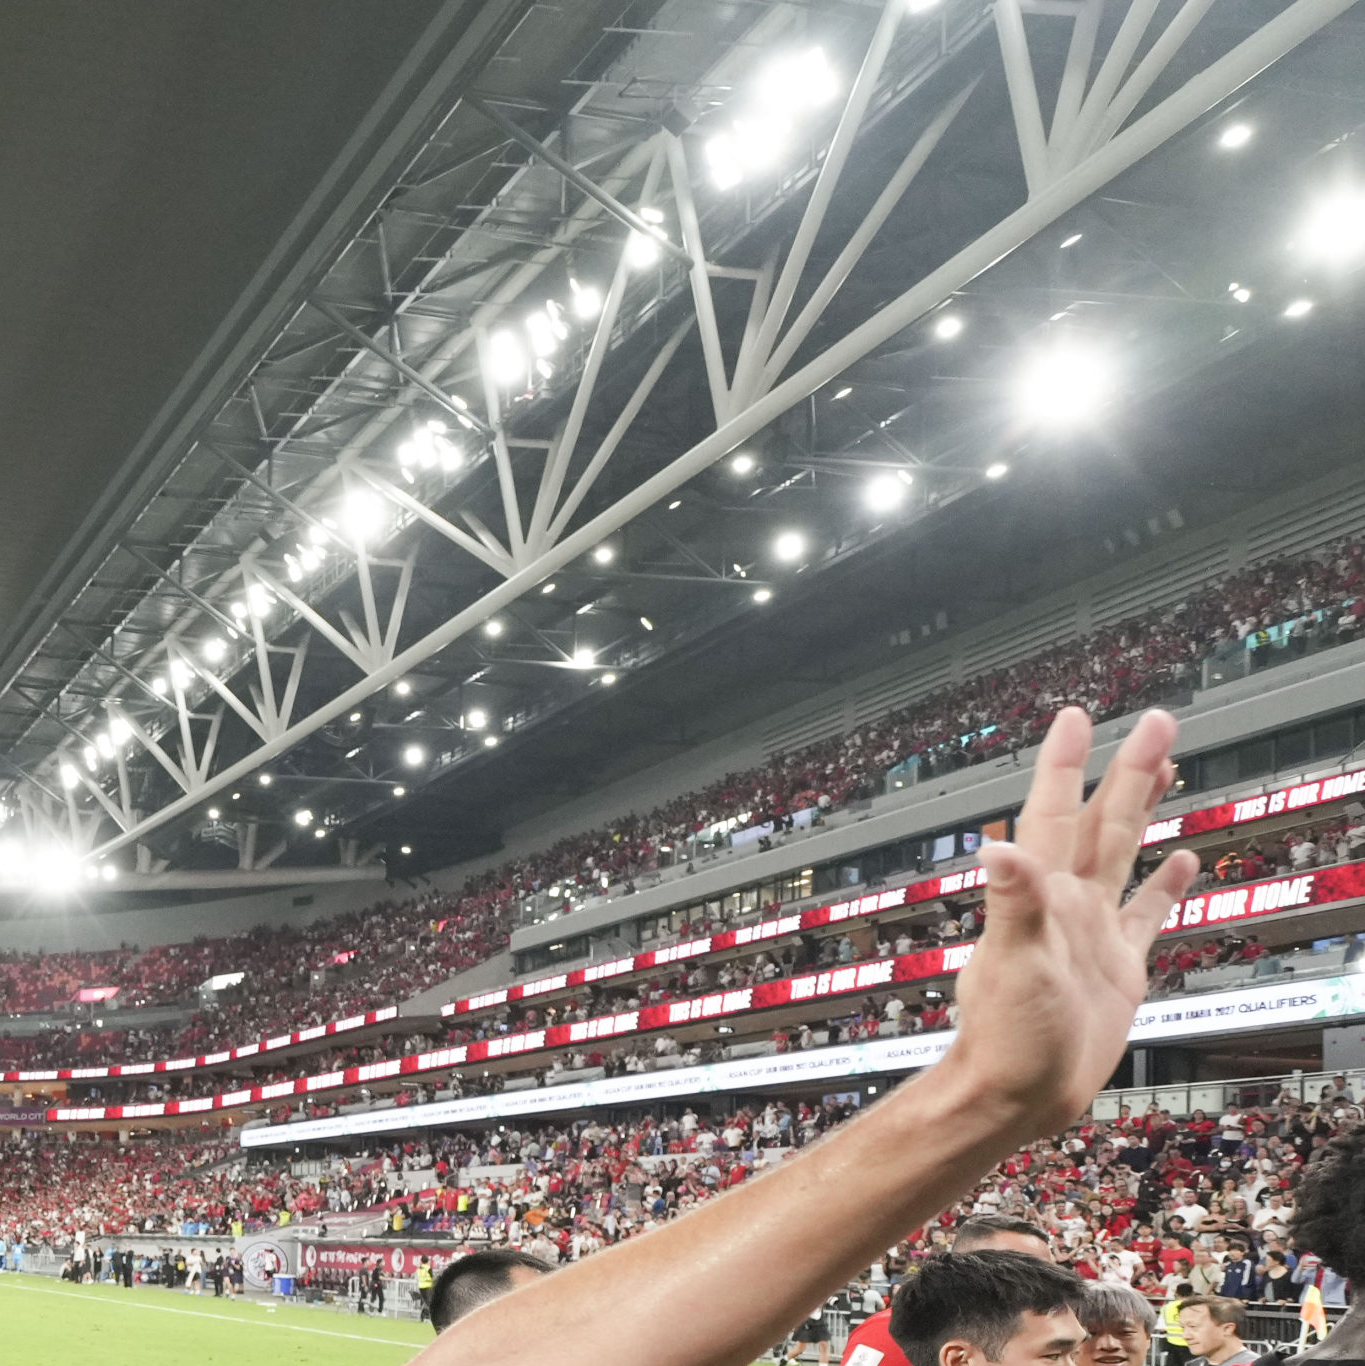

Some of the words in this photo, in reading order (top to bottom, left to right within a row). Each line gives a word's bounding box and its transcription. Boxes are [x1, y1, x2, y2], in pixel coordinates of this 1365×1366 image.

[1233, 796, 1267, 822] THIS
[1268, 791, 1287, 814] IS
[1287, 783, 1320, 808] OUR
[1321, 769, 1365, 800] HOME
[1182, 897, 1205, 925] IS
[1207, 889, 1248, 921] OUR
[1250, 876, 1314, 913] HOME
[790, 976, 817, 1000] THIS
[816, 973, 831, 994] IS
[830, 968, 856, 991] OUR
[856, 960, 894, 987] HOME
[1133, 1016, 1156, 1027] CUP
[1215, 1005, 1235, 1017] 2027
[1238, 994, 1317, 1014] QUALIFIERS
[886, 1049, 912, 1058] ASIAN
[914, 1046, 931, 1056] CUP
